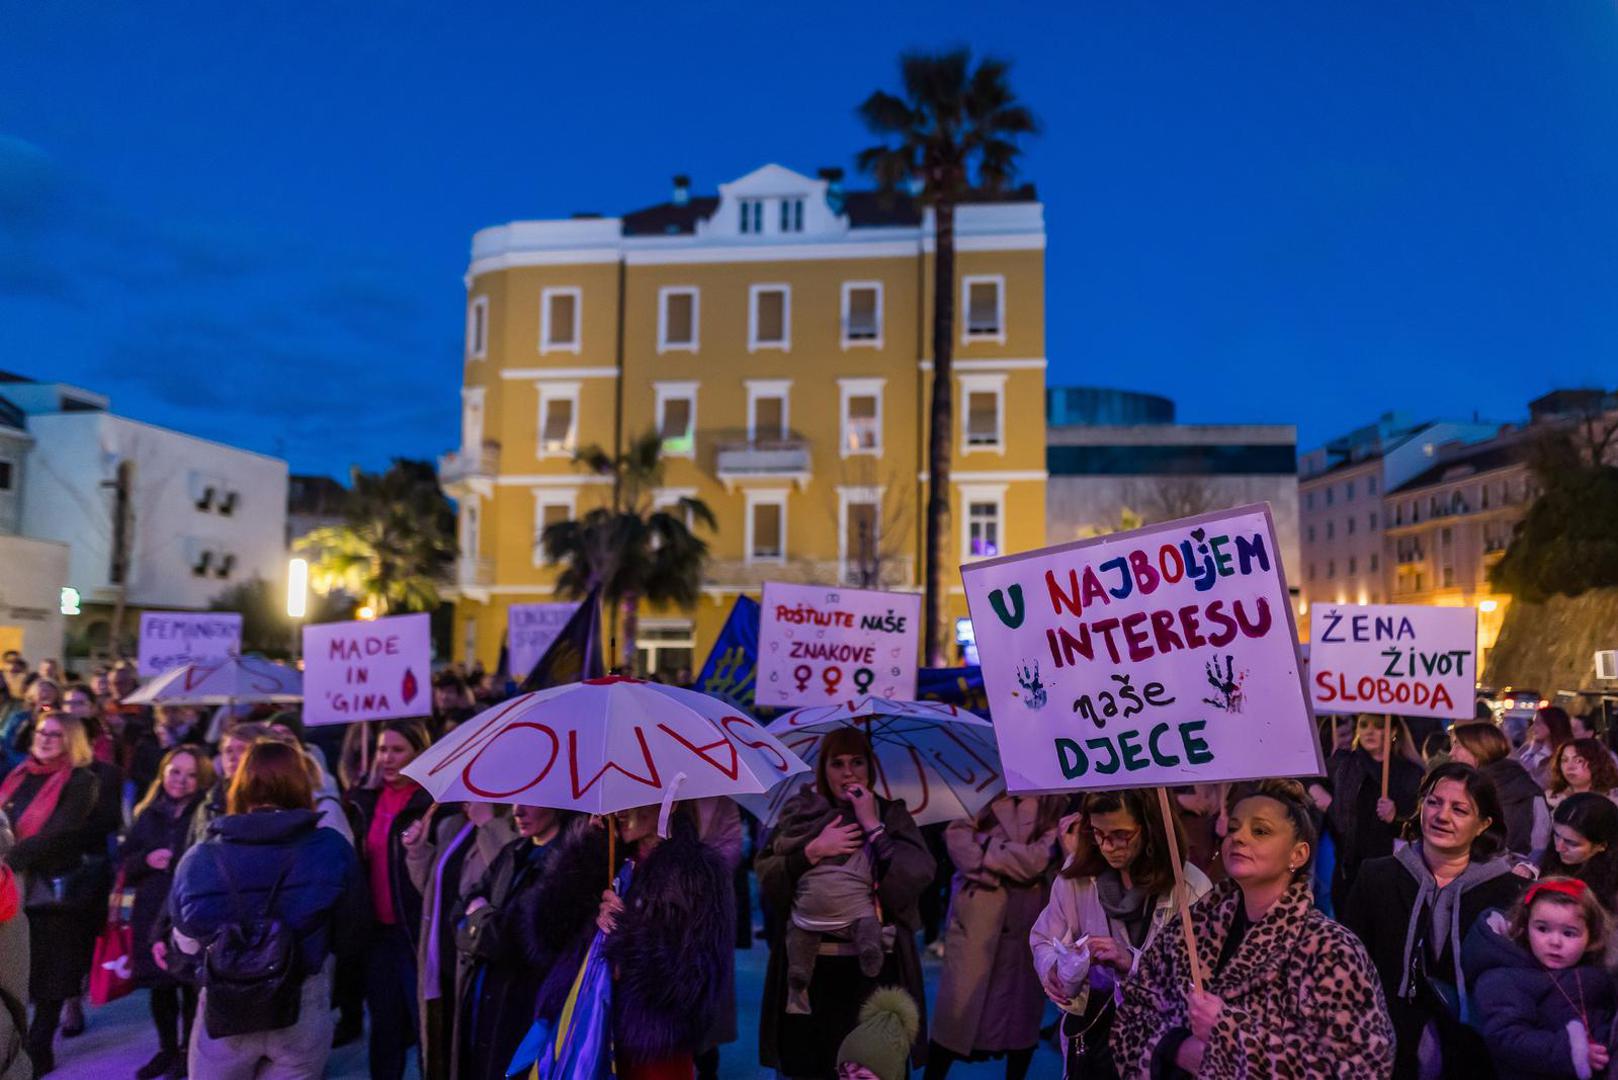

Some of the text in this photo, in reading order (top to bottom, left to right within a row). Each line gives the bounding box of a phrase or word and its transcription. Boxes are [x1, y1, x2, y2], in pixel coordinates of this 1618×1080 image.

[860, 608, 908, 634] NAŠE
[987, 583, 1025, 630] U
[1046, 596, 1273, 669] INTERESU
[1320, 608, 1417, 643] ŽENA
[329, 635, 400, 660] MADE
[789, 641, 876, 664] ZNAKOVE
[346, 665, 369, 684] IN
[1315, 670, 1454, 710] SLOBODA
[1073, 674, 1177, 729] naše
[1054, 719, 1215, 780] DJECE
